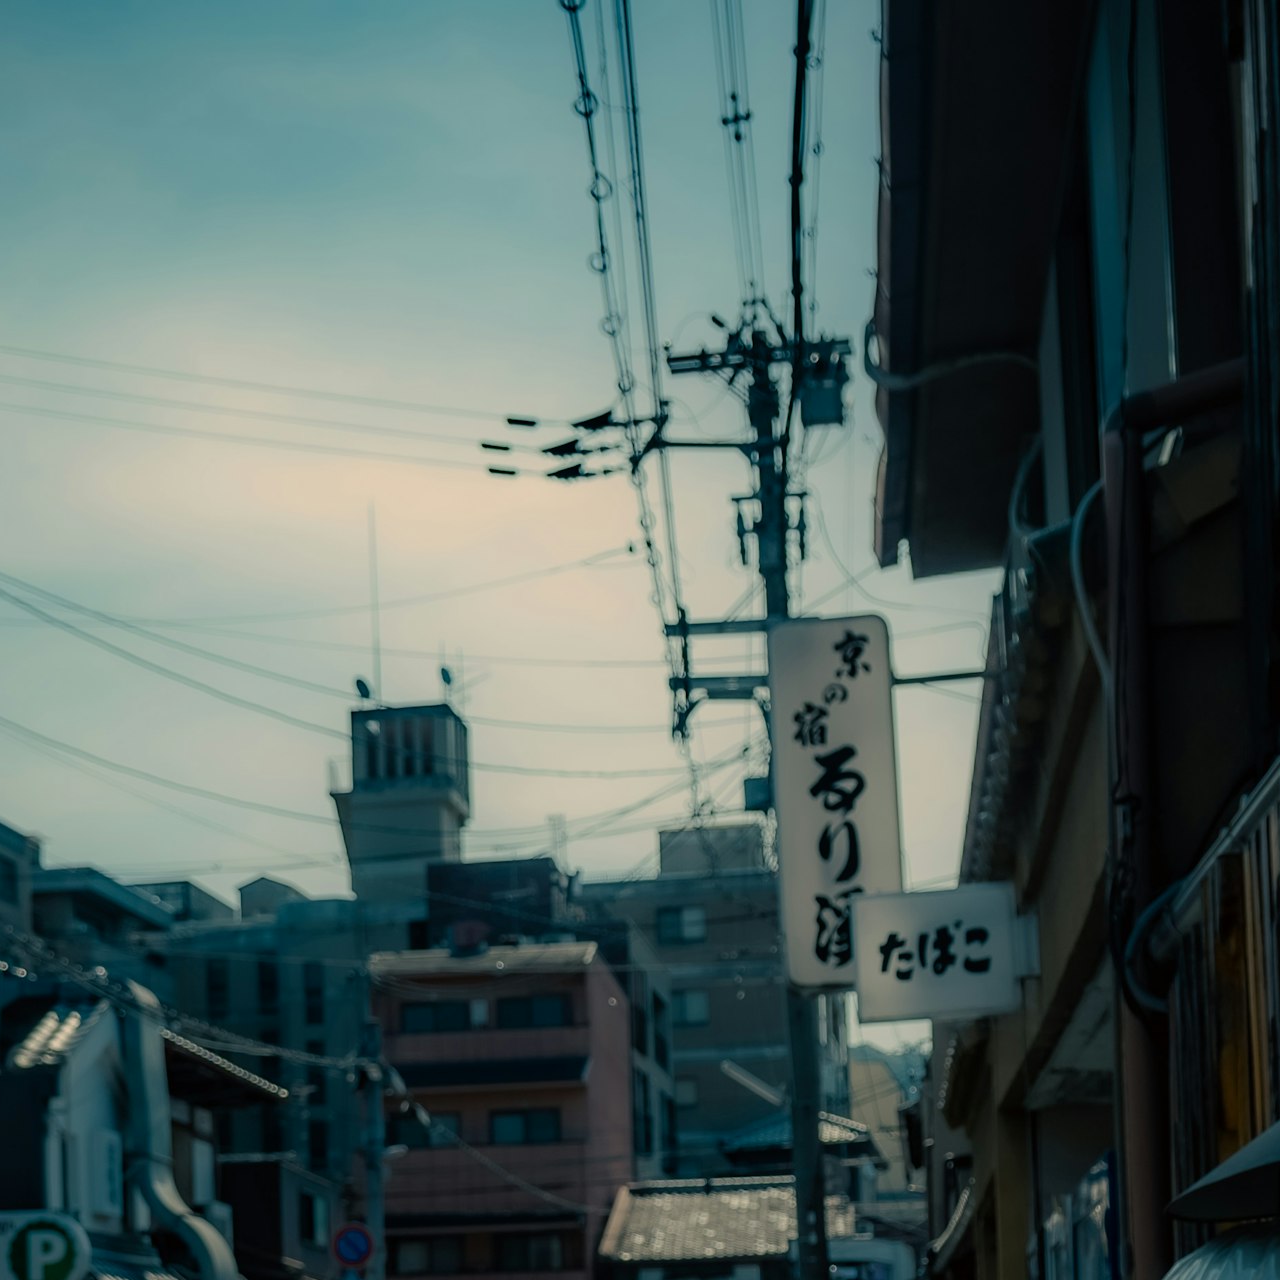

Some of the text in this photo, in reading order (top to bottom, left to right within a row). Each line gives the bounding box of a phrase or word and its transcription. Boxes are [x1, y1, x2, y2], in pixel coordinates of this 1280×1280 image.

[793, 630, 871, 747] 京の宿
[879, 919, 990, 980] たばこ
